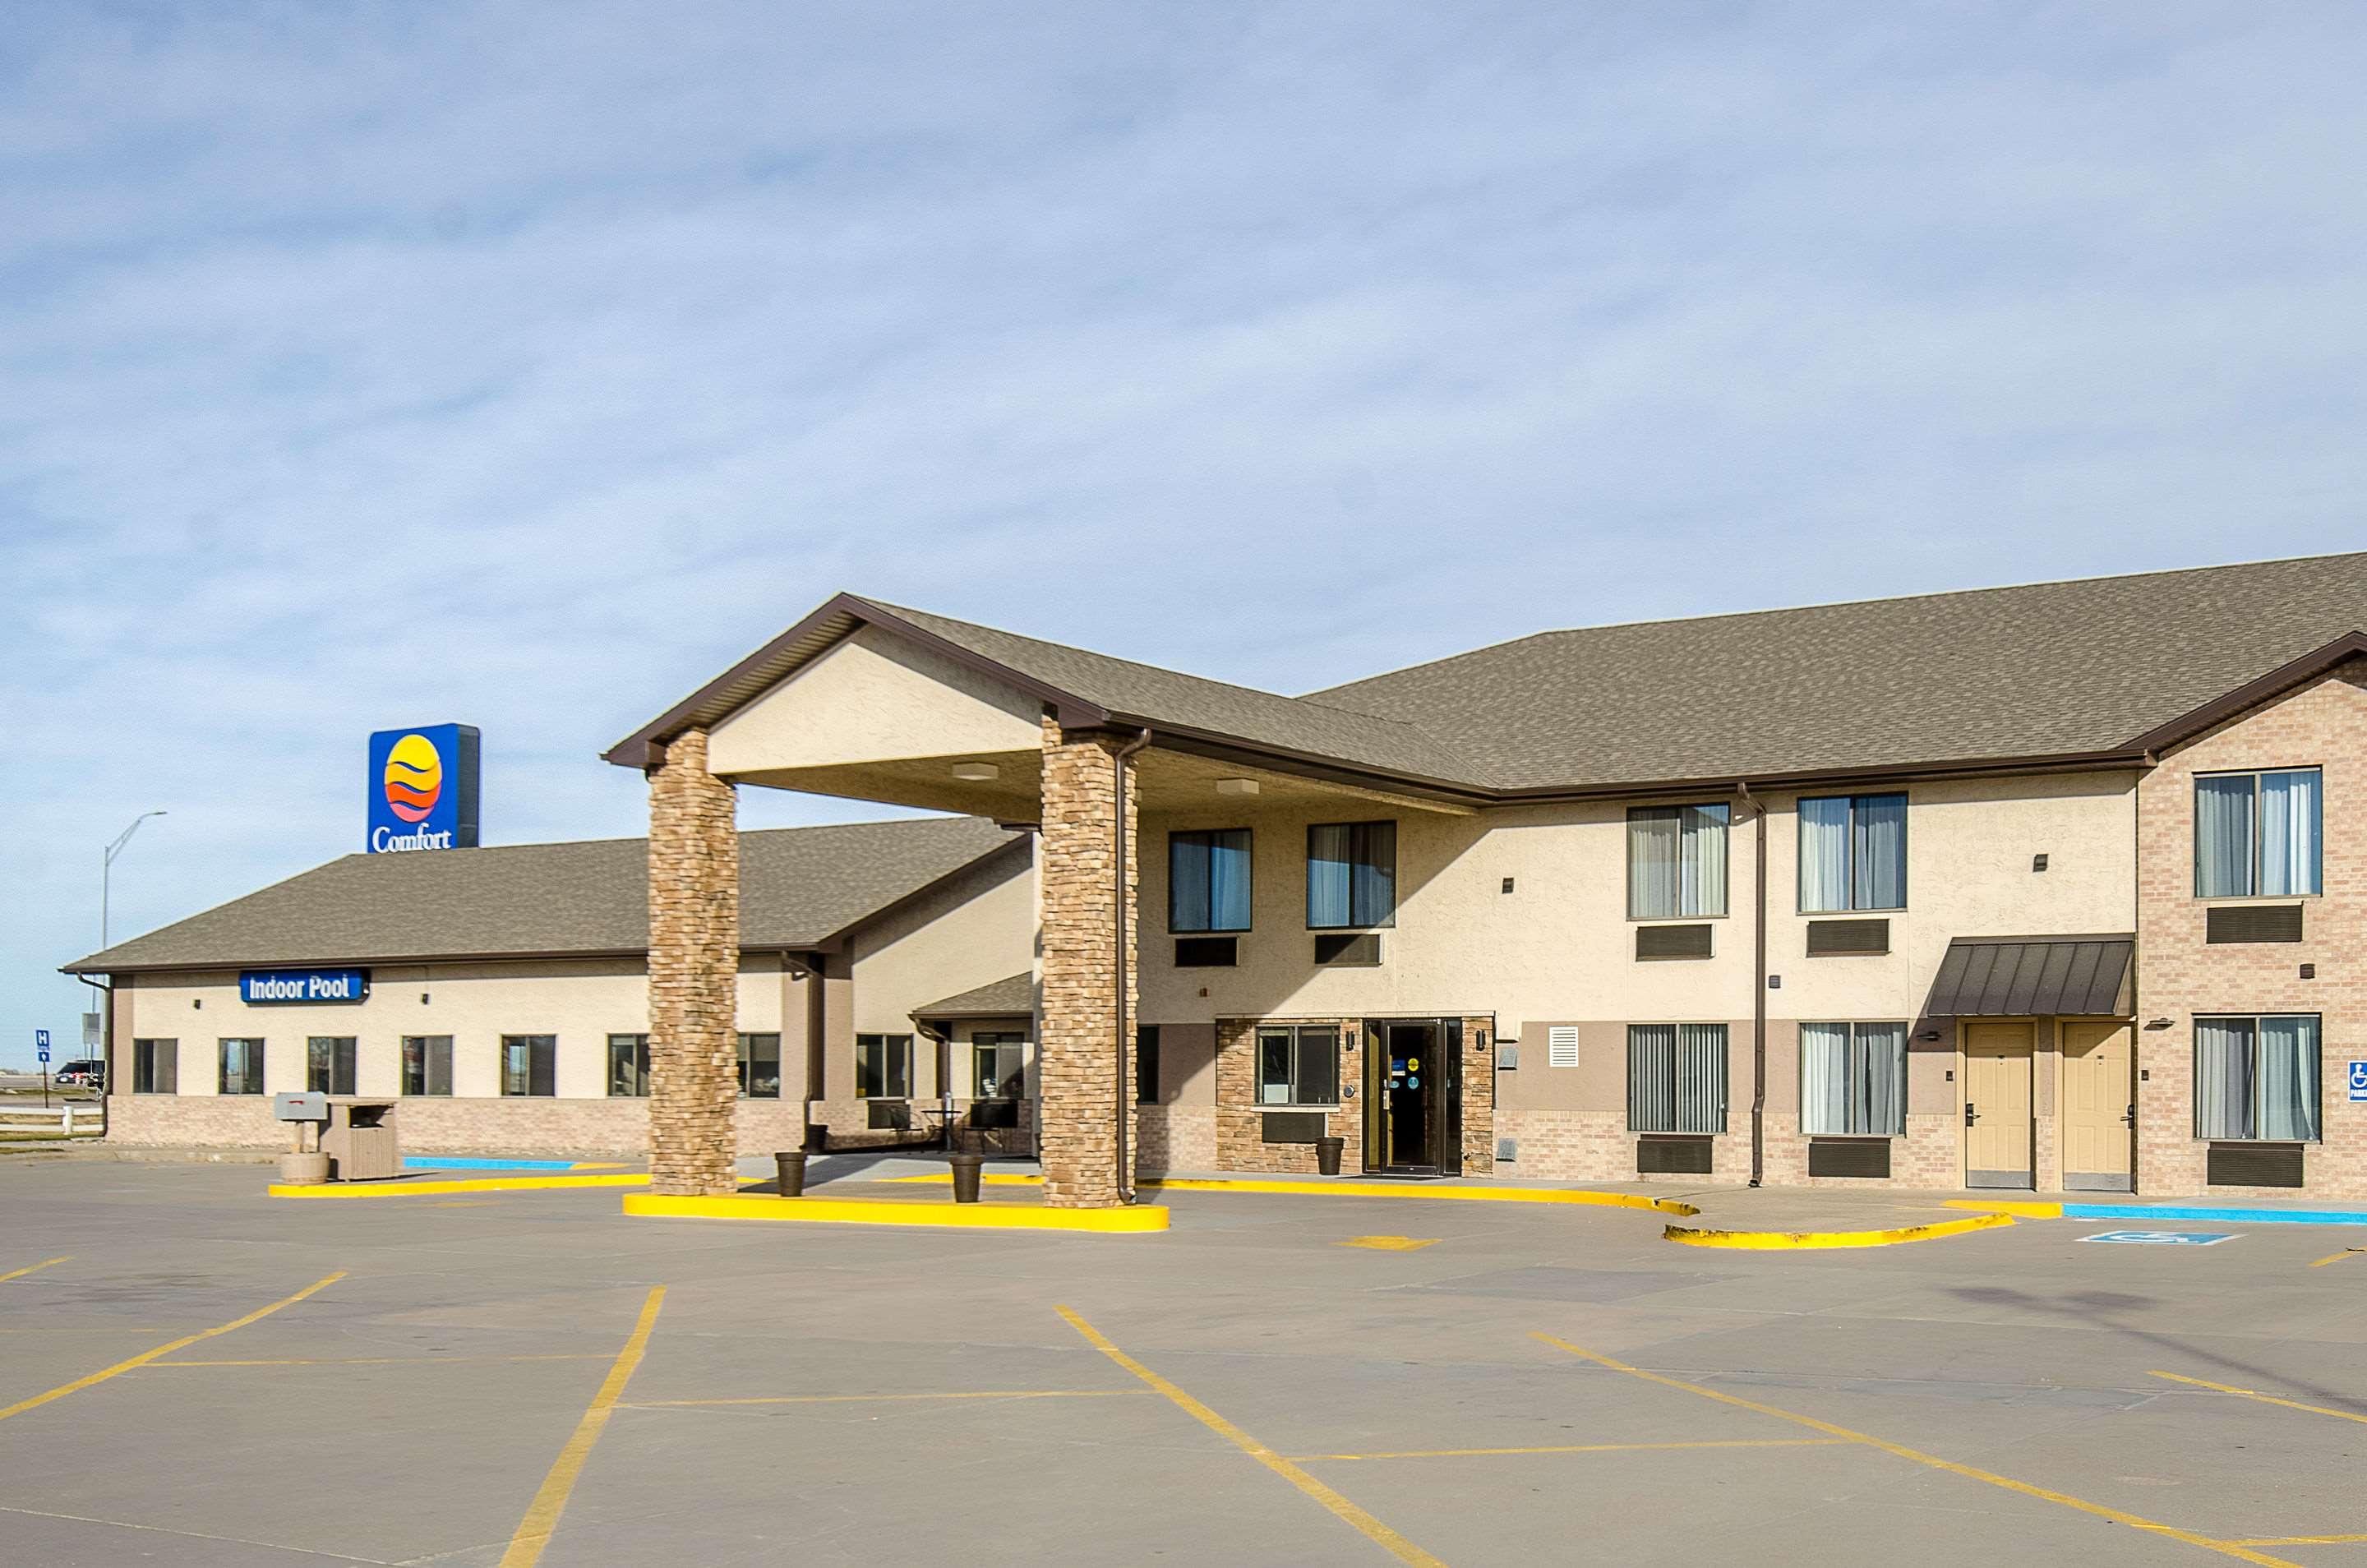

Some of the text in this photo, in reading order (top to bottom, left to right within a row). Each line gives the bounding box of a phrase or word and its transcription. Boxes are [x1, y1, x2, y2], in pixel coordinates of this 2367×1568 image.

[372, 823, 451, 853] Comfort
[249, 974, 349, 998] Indoor Pool
[38, 1031, 48, 1045] H
